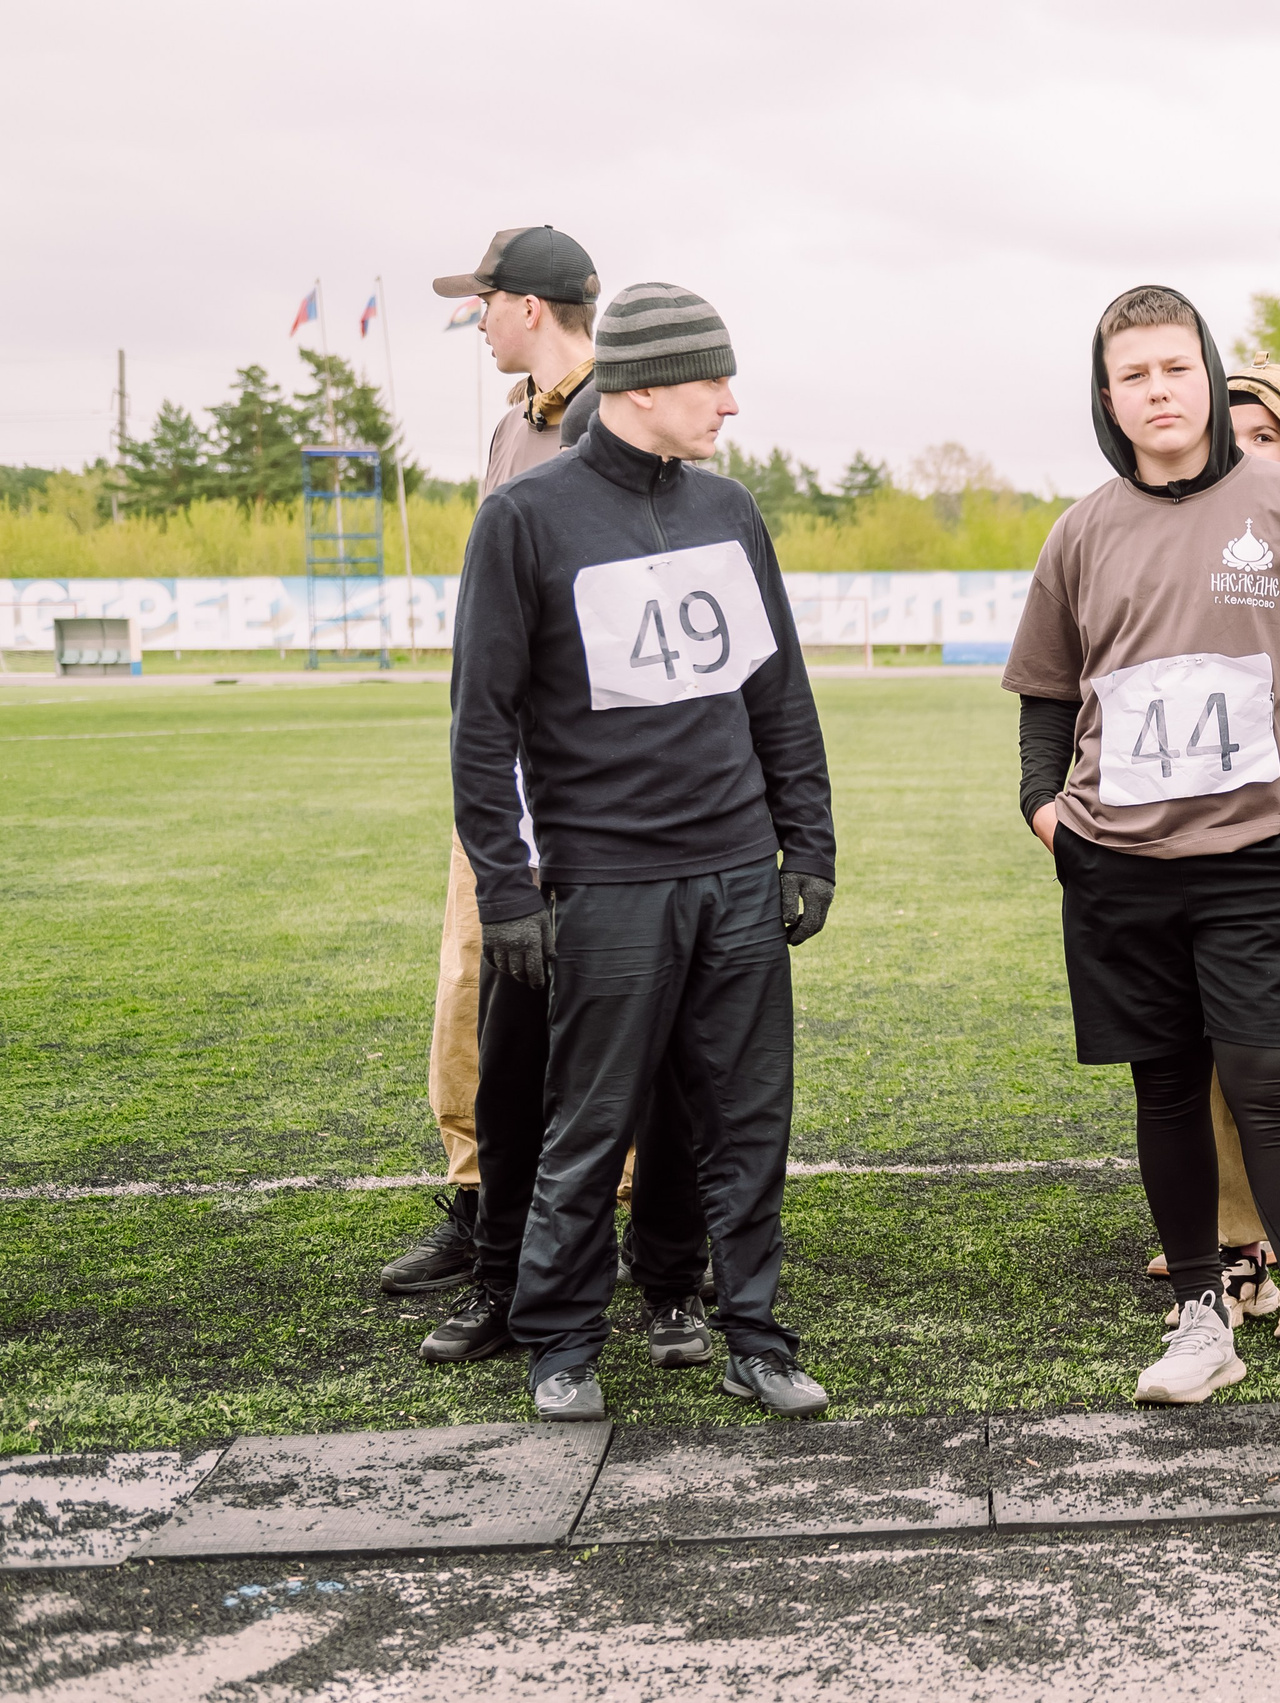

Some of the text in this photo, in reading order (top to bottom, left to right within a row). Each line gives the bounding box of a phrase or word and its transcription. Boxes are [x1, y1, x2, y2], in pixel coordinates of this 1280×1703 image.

[629, 590, 731, 681] 49
[1224, 594, 1275, 609] Кемерово
[1130, 692, 1240, 778] 44
